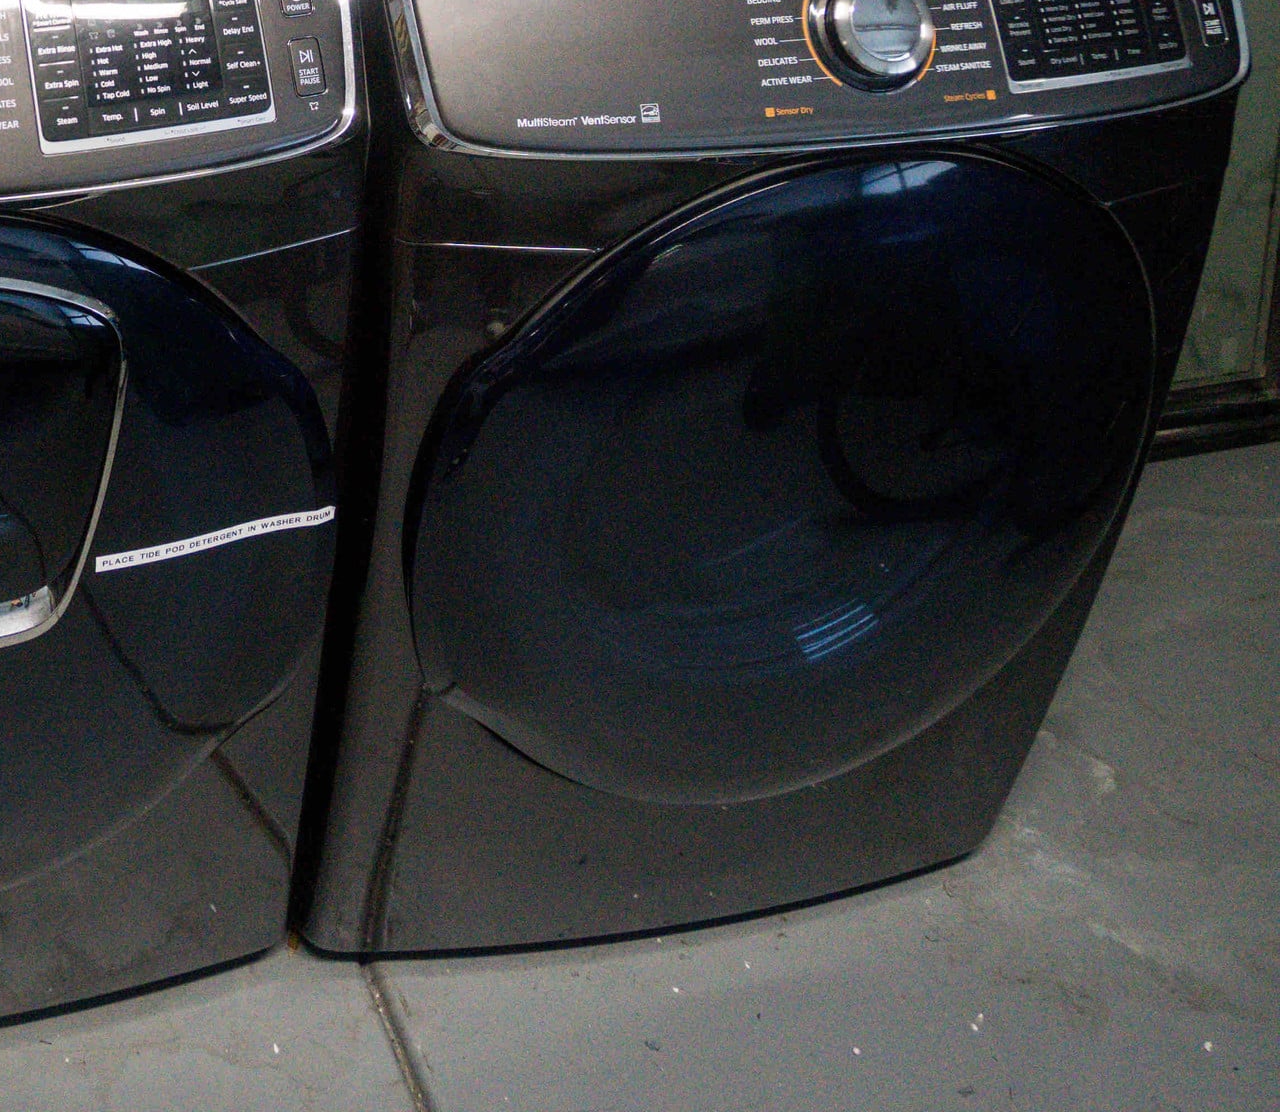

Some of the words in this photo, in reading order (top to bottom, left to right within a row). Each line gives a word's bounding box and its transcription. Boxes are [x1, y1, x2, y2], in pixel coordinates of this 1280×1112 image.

[287, 3, 310, 12] POWER
[750, 17, 771, 26] PERM
[772, 16, 793, 24] PRESS
[950, 21, 983, 30] REFRESH
[223, 27, 241, 36] Delay
[242, 25, 254, 34] End
[158, 39, 172, 47] High
[754, 37, 777, 46] WOOL
[38, 46, 56, 55] Extra
[226, 62, 238, 70] Self
[758, 56, 798, 67] DELICATES
[144, 63, 168, 71] Medium
[935, 64, 958, 73] STEAM
[960, 61, 992, 71] SANITIZE
[299, 68, 319, 76] START
[45, 82, 63, 90] Extra
[64, 79, 79, 89] Spin
[100, 80, 115, 88] Cold
[193, 80, 209, 89] Light
[300, 77, 320, 86] PAUSE
[761, 77, 788, 87] ACTIVE
[789, 75, 812, 85] WEAR
[157, 84, 171, 93] Spin
[102, 92, 115, 101] Tap
[116, 90, 131, 98] Cold
[229, 96, 248, 105] Super
[248, 93, 267, 103] Speed
[187, 102, 200, 112] Soil
[201, 101, 219, 110] Level
[150, 108, 166, 117] Spin
[775, 107, 798, 117] Sensor
[800, 106, 814, 116] Dry
[57, 117, 78, 126] Steam
[581, 115, 637, 125] VentSensor
[102, 555, 134, 567] PLACE
[140, 550, 161, 560] TIDE
[165, 544, 185, 555] POD
[189, 529, 243, 549] DETERGENT
[248, 524, 257, 533] IN
[261, 516, 301, 530] WASHER
[306, 510, 331, 522] DRUM
